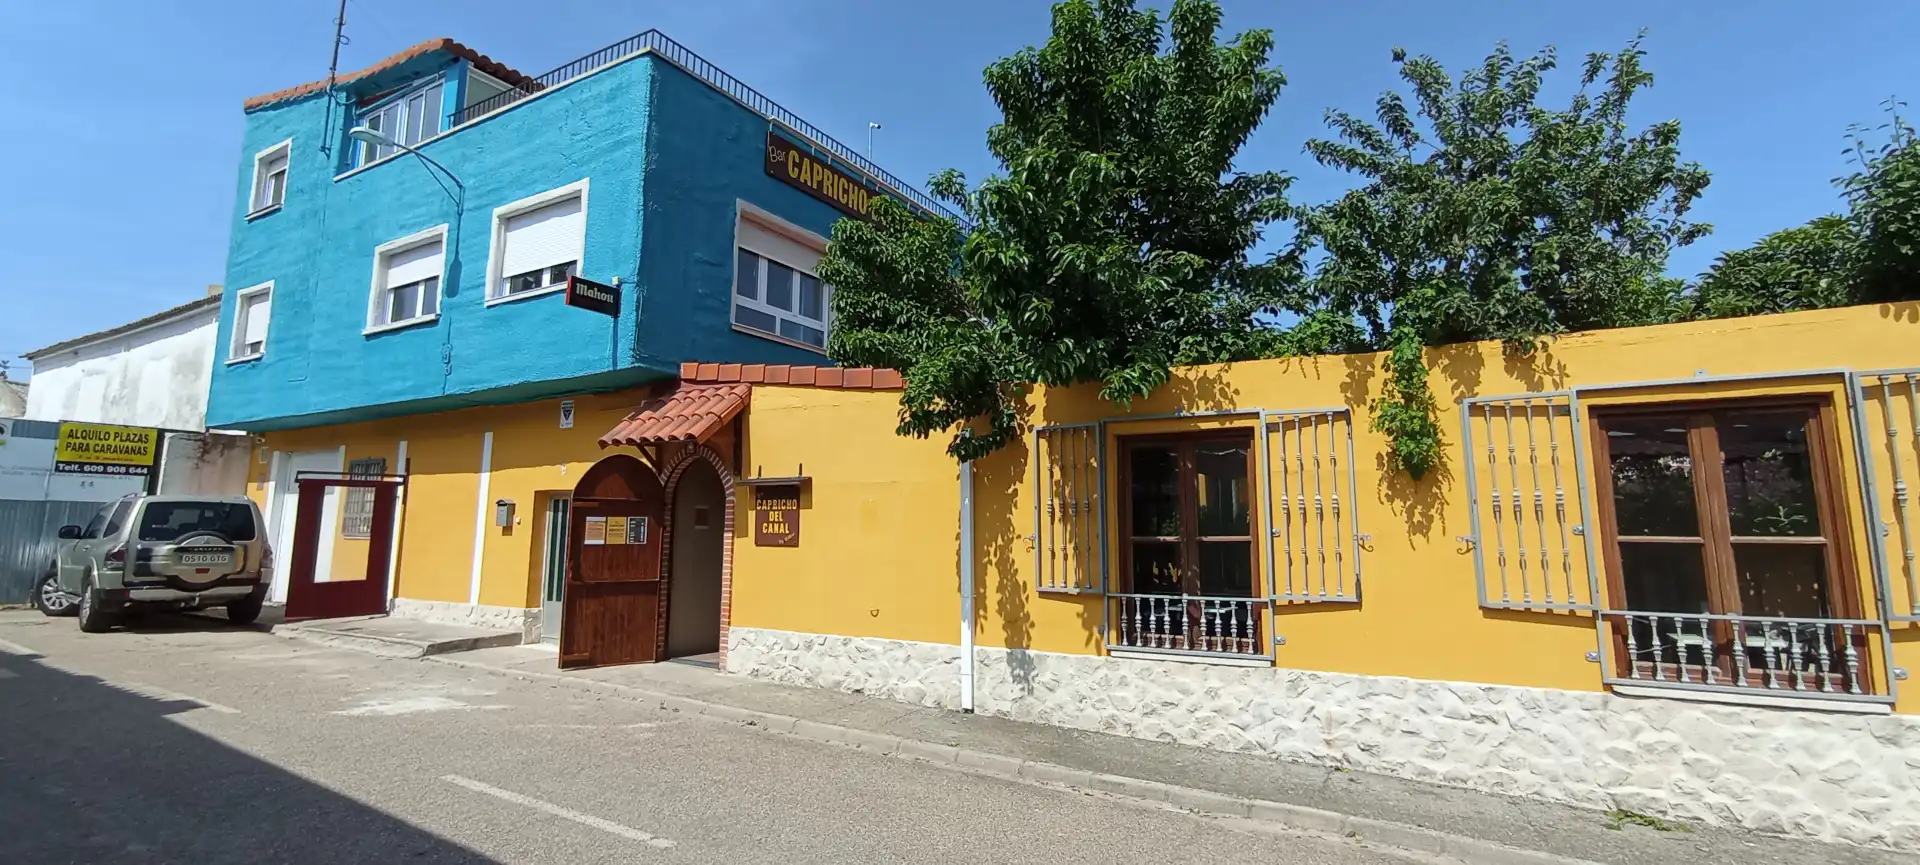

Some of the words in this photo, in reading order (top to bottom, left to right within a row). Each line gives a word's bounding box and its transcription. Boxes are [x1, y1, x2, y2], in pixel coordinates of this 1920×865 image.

[769, 146, 786, 163] Bar
[787, 150, 868, 215] CAPRICHO
[576, 283, 614, 303] Mahou
[67, 428, 111, 441] ALQUILO
[113, 432, 149, 444] PLAZAS
[65, 441, 90, 453] PARA
[93, 443, 148, 456] CARAVANAS
[58, 463, 80, 471] Telf.
[84, 464, 104, 472] 609
[107, 465, 126, 473] 908
[129, 466, 148, 474] 644
[756, 499, 798, 510] CAPRICHO
[769, 511, 783, 521] DEL
[762, 523, 790, 534] CANAL
